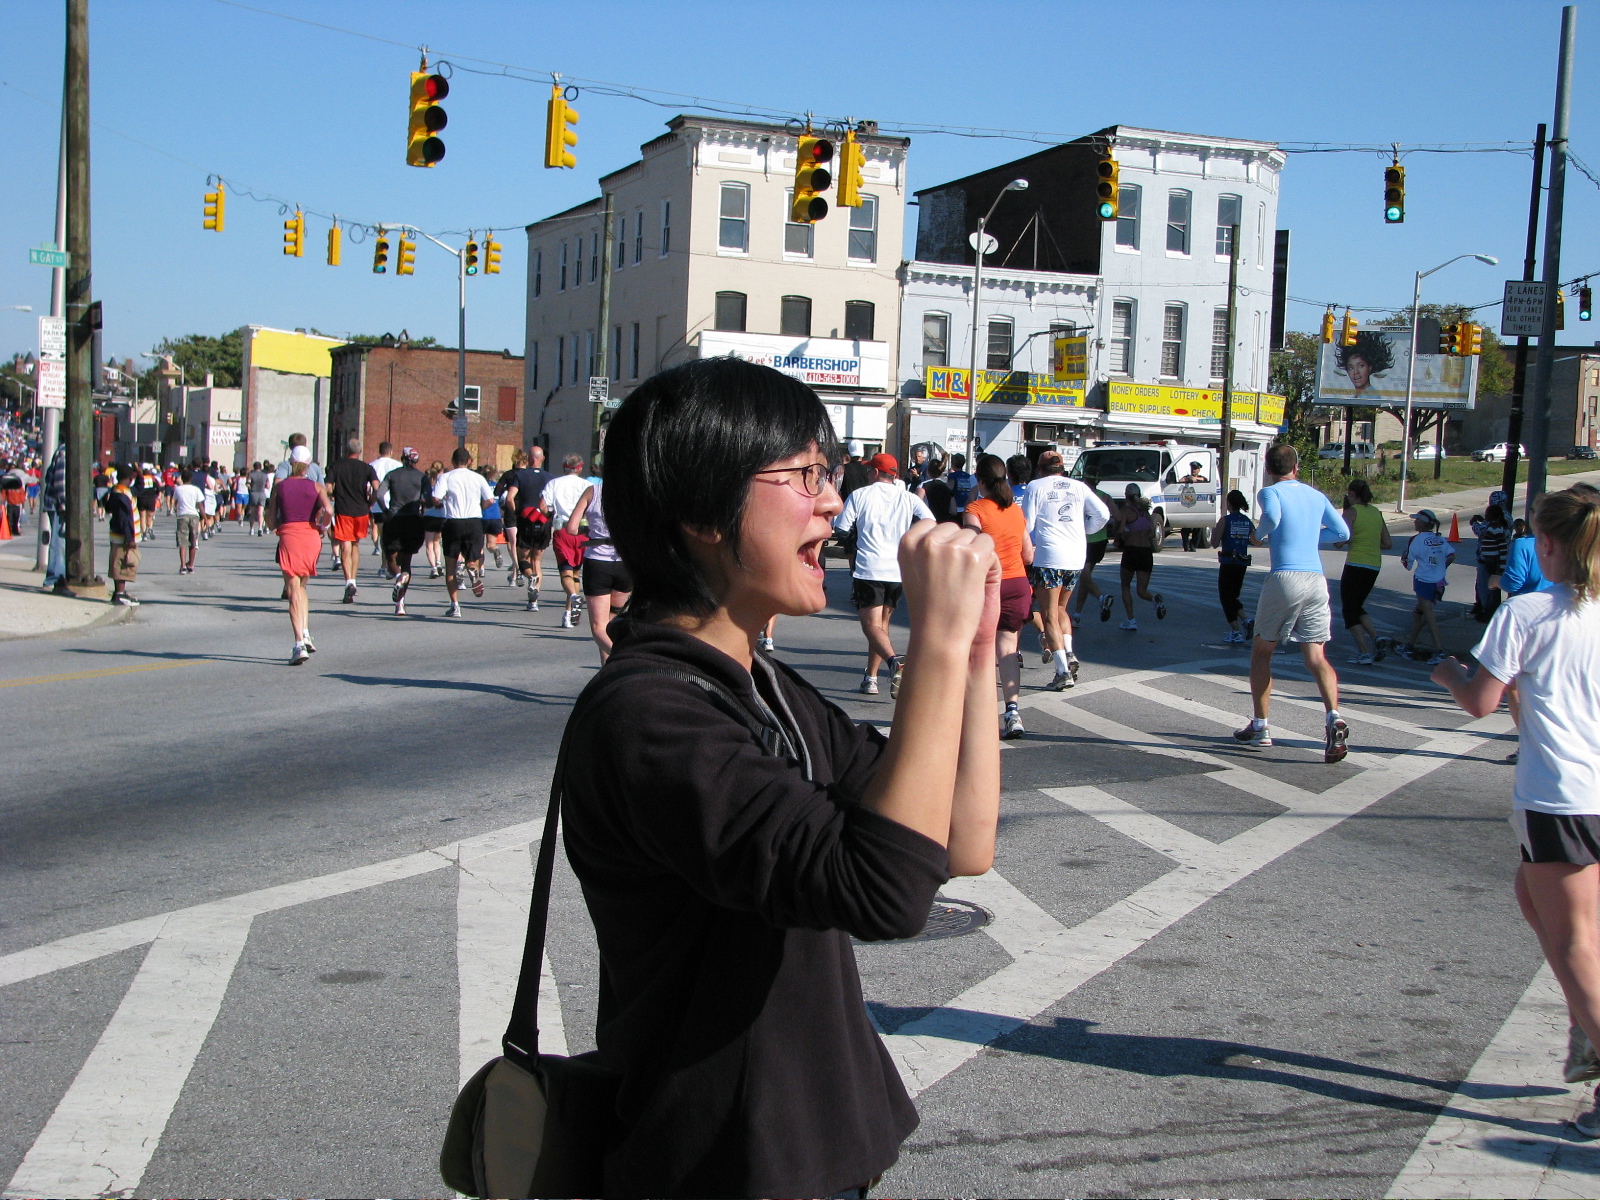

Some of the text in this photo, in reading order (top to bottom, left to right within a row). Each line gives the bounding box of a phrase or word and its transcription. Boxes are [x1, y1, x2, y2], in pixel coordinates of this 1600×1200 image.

[31, 251, 37, 261] N
[40, 251, 55, 264] GAY
[1507, 285, 1544, 295] 2 LANES
[1507, 296, 1543, 305] 4PM-6PM
[1524, 306, 1542, 314] LANES
[1520, 315, 1541, 323] OTHER
[52, 323, 63, 331] NO
[773, 355, 858, 372] BARBERSHOP
[807, 372, 859, 384] 410-563-1000
[1035, 394, 1077, 406] MART
[1111, 385, 1133, 395] MONEY
[1134, 386, 1160, 397] ORDERS
[1169, 390, 1199, 401] LOTTERY
[1212, 392, 1254, 405] GRERIES
[1110, 401, 1136, 412] BEAUTY
[1138, 404, 1171, 415] SUPPLIES
[1191, 408, 1216, 418] CHECK
[1231, 411, 1253, 421] SHING
